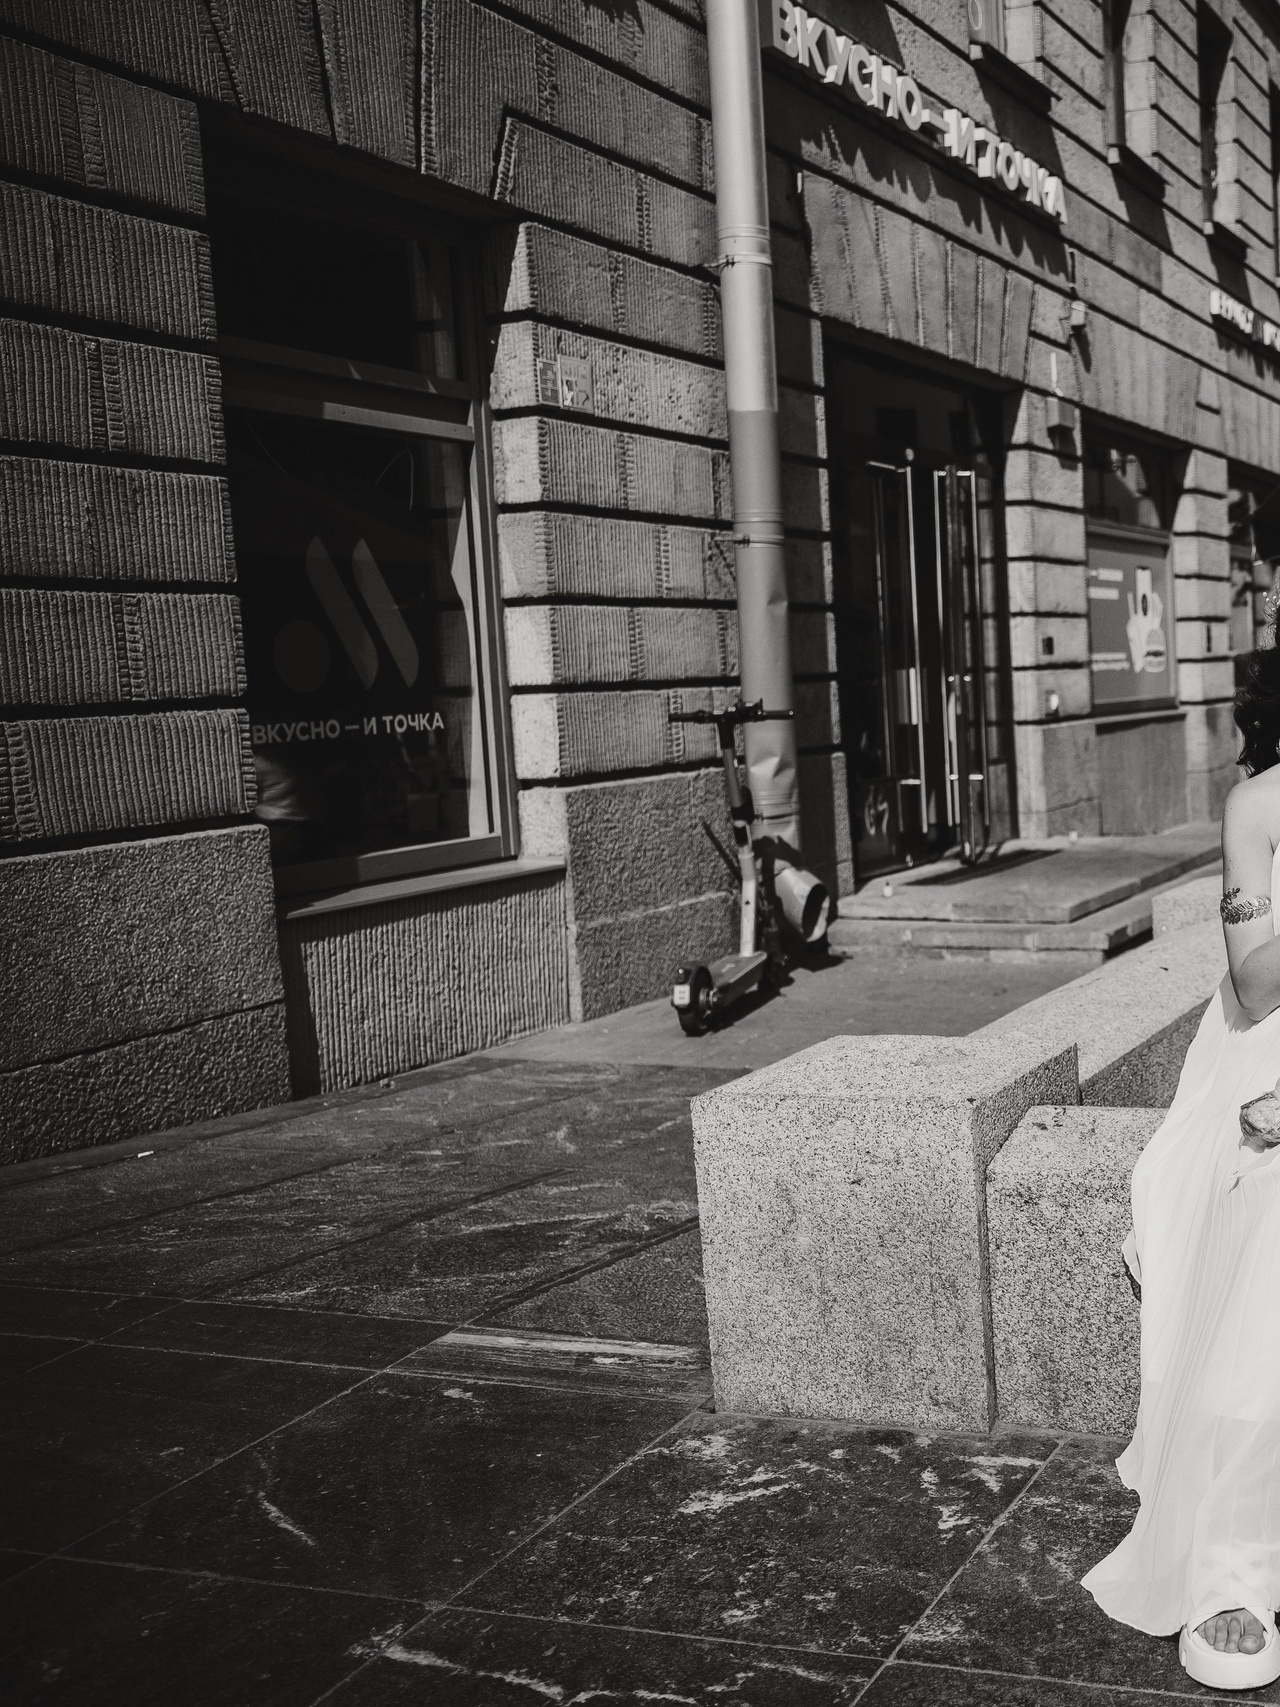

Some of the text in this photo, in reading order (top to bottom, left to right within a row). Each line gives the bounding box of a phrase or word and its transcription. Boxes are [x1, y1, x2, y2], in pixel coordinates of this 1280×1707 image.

[772, 0, 923, 131] ВКУСНО
[943, 108, 976, 167] И
[974, 127, 1068, 225] ТОЧКА
[252, 719, 341, 745] ВКУСНО
[363, 716, 378, 736] И
[382, 711, 445, 734] ТОЧКА
